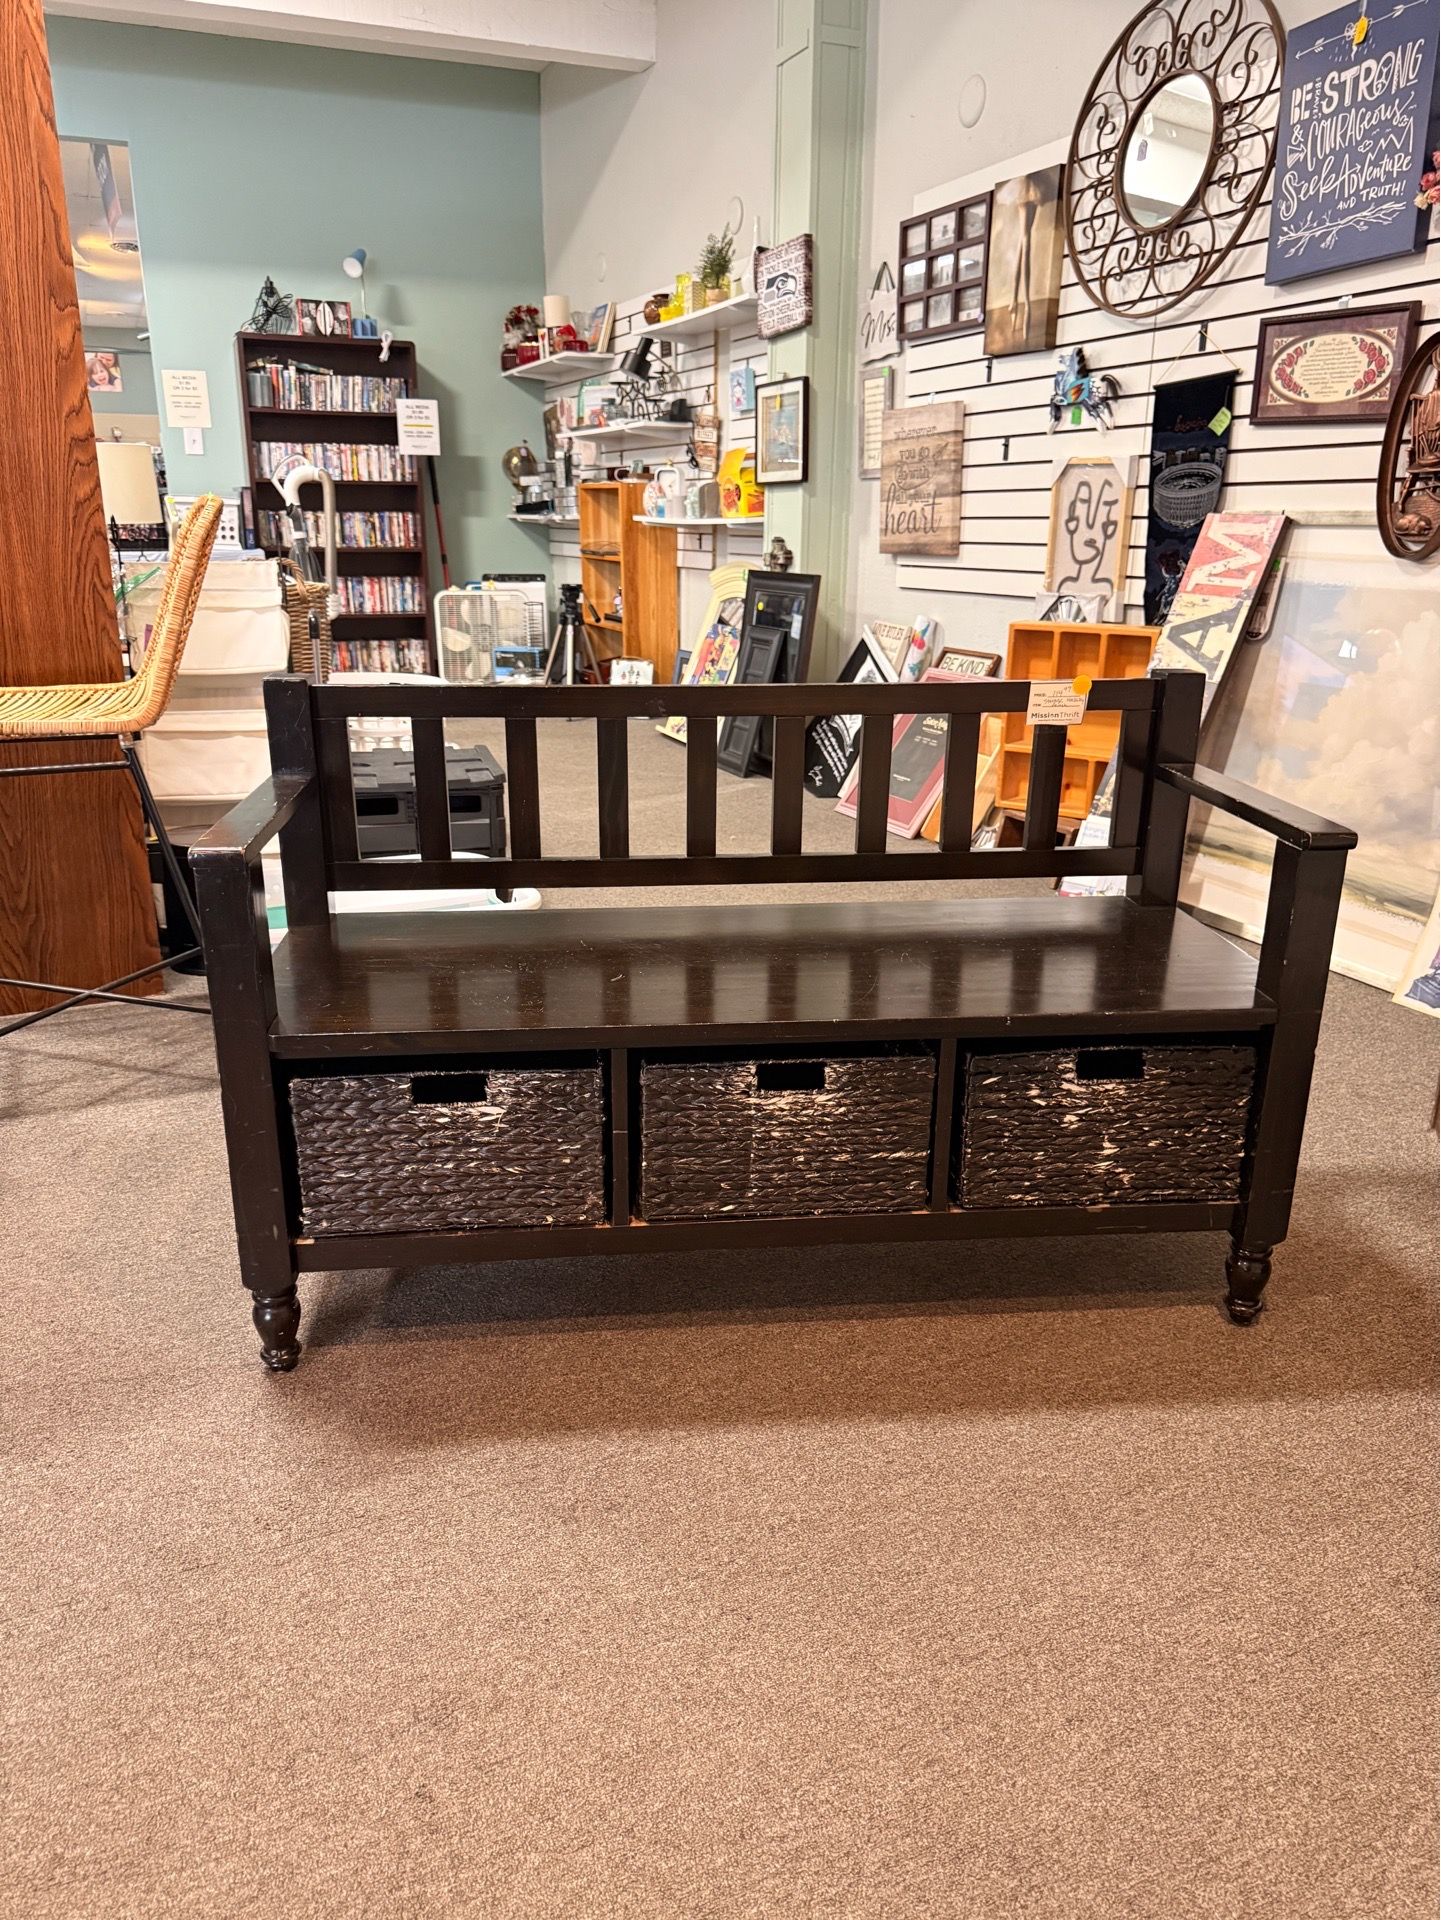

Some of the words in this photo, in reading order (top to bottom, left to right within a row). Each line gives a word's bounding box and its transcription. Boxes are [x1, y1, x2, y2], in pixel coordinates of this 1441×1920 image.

[1322, 38, 1425, 116] STRONG
[1290, 81, 1314, 126] BE
[1336, 197, 1357, 211] AND
[1360, 179, 1407, 203] TRUTH!
[884, 482, 943, 537] heart
[941, 656, 959, 671] BE
[956, 658, 985, 675] KIND
